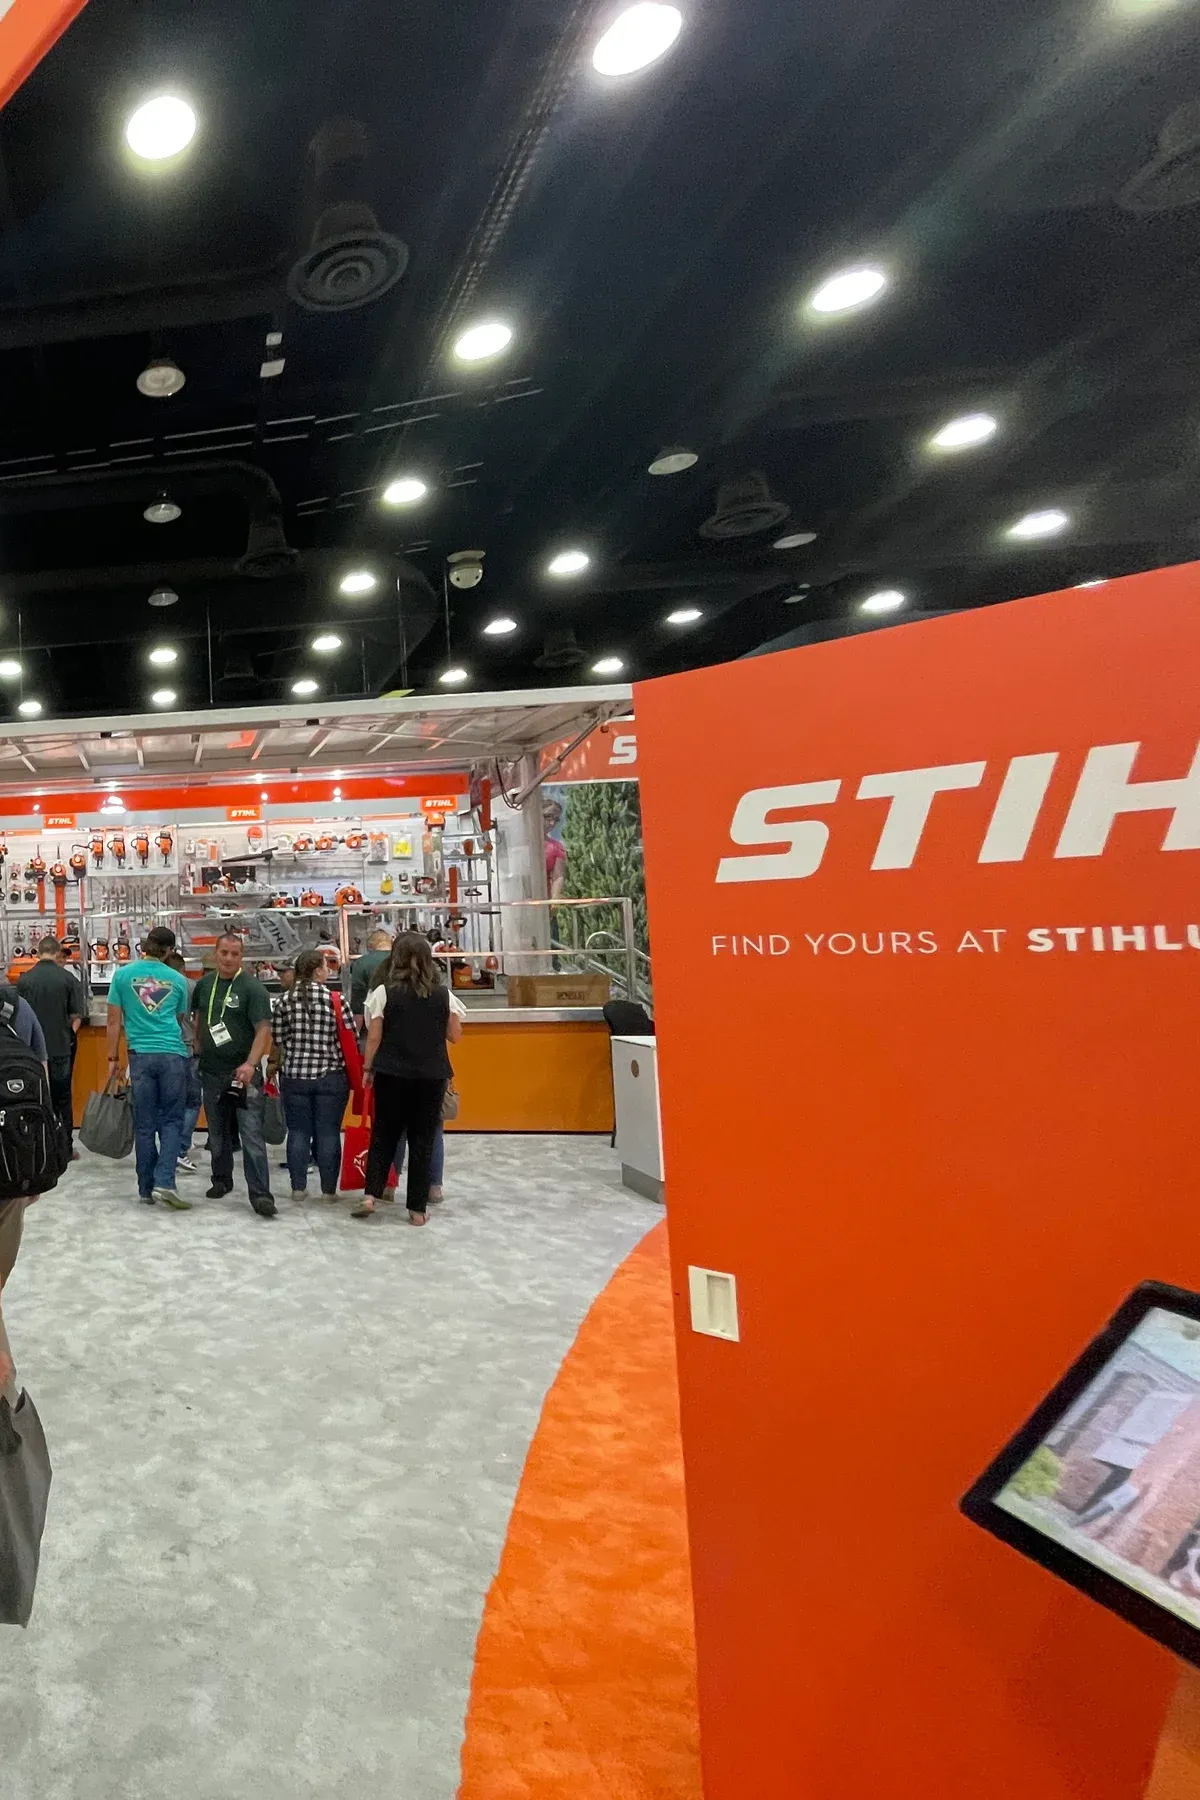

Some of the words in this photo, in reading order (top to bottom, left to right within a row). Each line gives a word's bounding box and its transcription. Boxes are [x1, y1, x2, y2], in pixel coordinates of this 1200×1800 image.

[230, 809, 258, 817] STIHL
[47, 817, 72, 825] STIHL
[711, 934, 791, 956] FIND
[804, 931, 938, 956] YOURS
[956, 929, 1008, 954] AT
